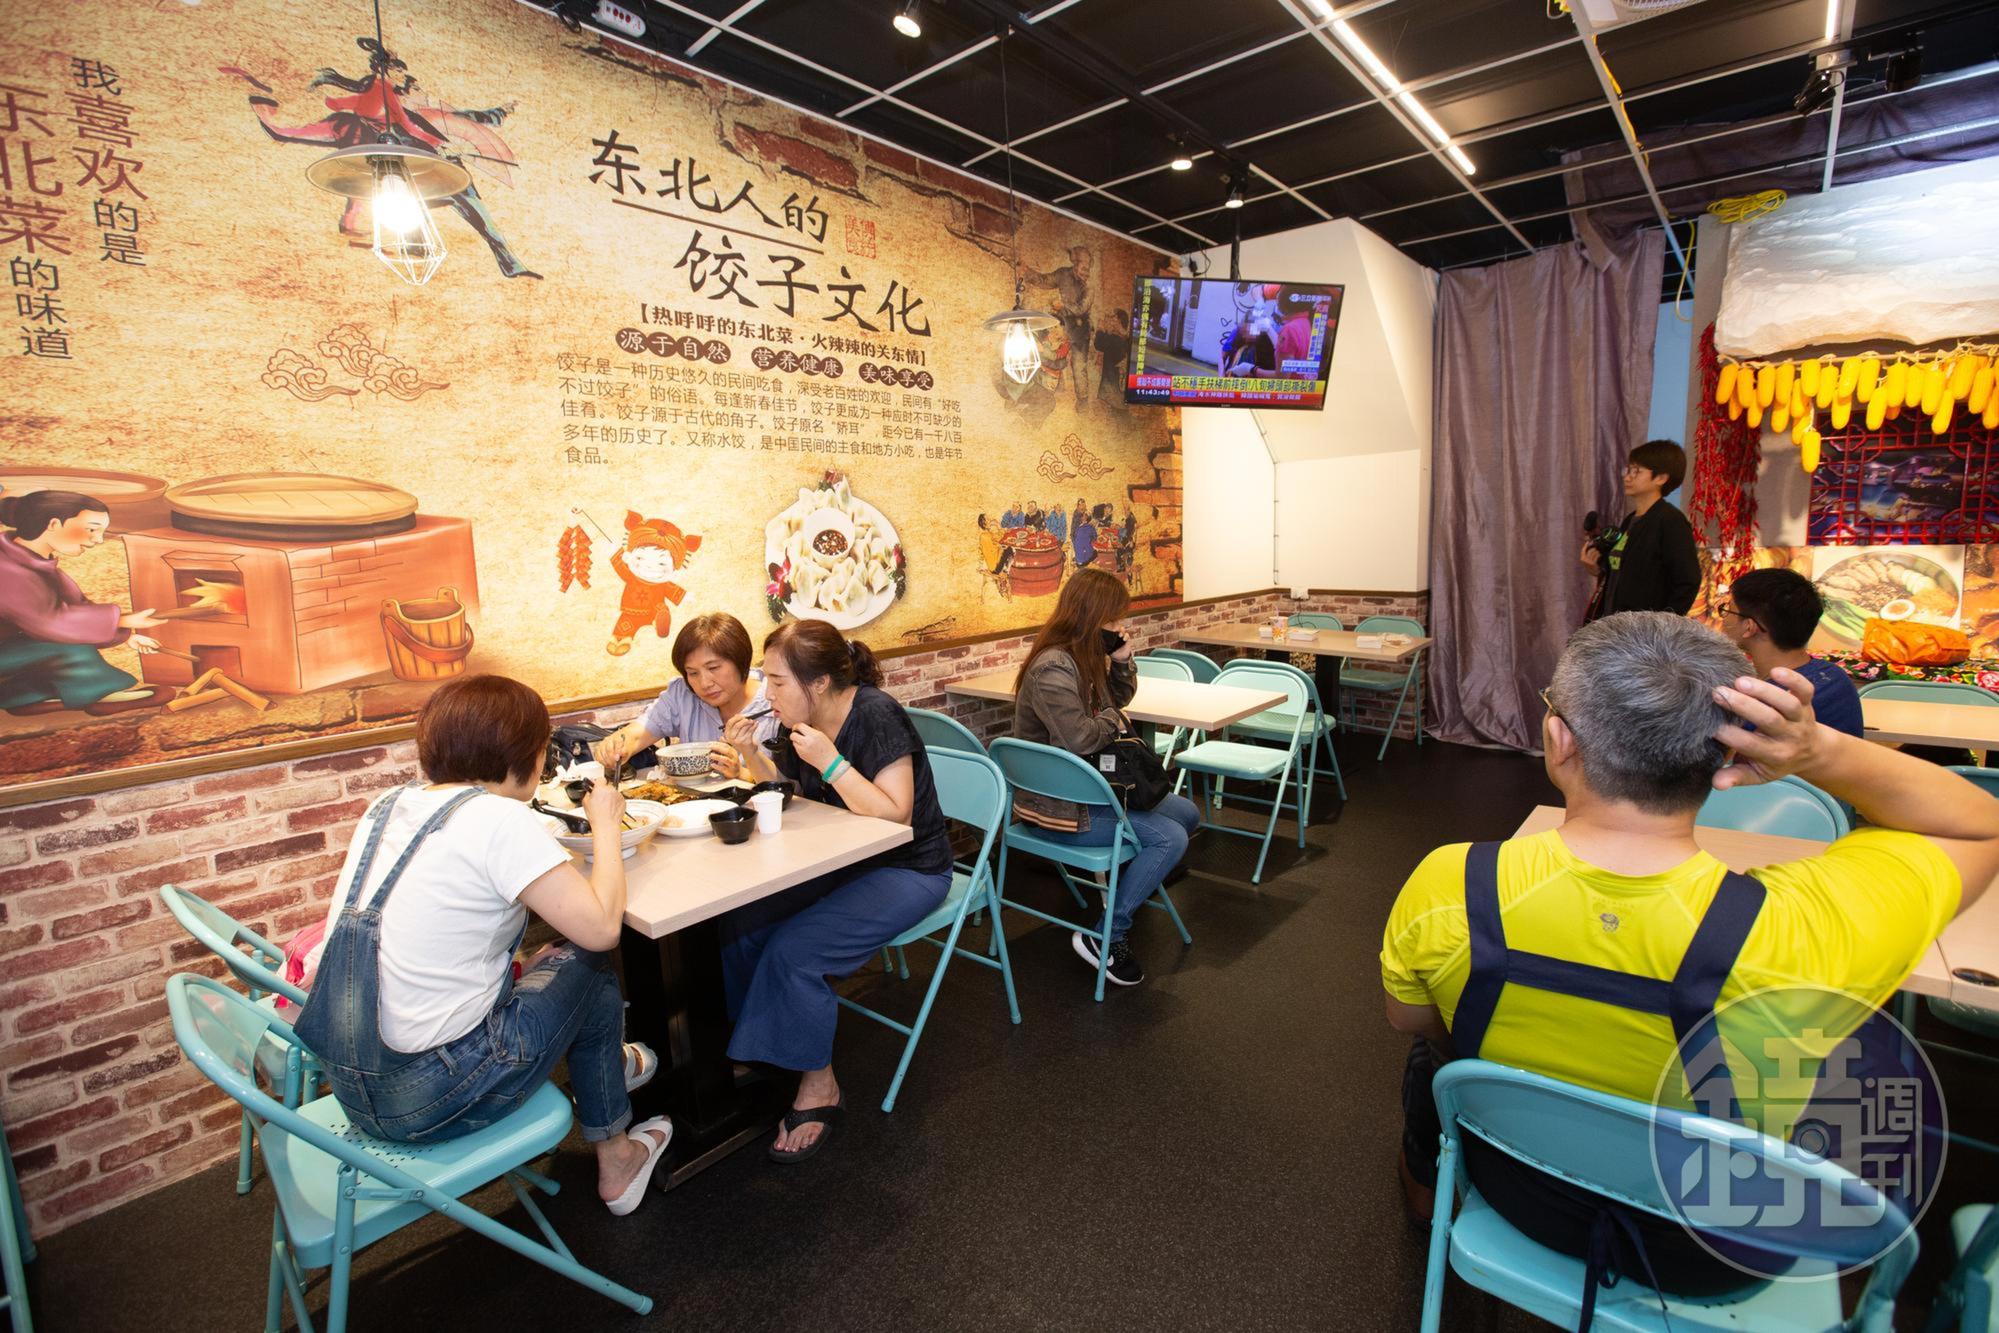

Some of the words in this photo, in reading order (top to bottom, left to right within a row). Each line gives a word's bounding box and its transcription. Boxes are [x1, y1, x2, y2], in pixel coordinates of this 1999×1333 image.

[64, 56, 148, 267] 我喜欢的是
[588, 129, 829, 244] 东北人的
[0, 83, 73, 360] 东北菜的味道
[673, 229, 932, 337] 饺子文化
[618, 329, 729, 362] 源于自然
[753, 347, 841, 377] 营养健康
[861, 362, 931, 389] 美味享受
[565, 446, 609, 465] 食品。
